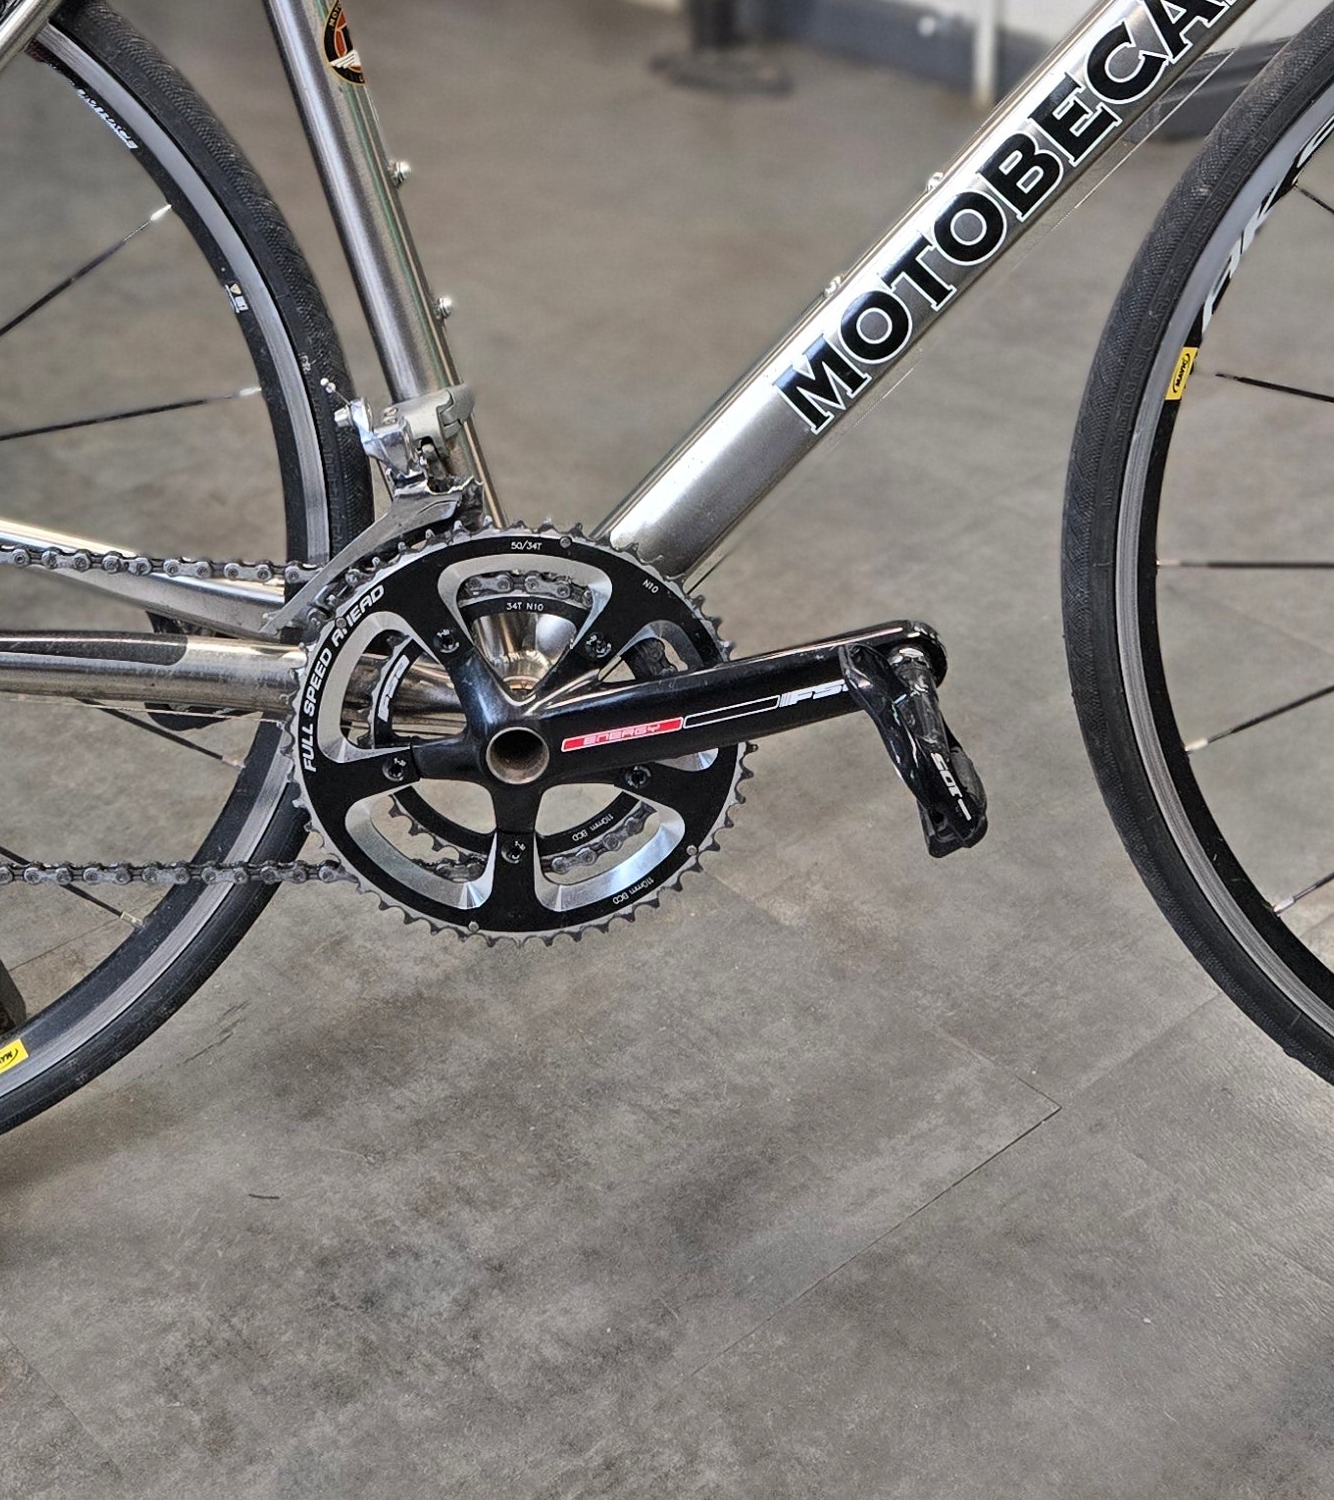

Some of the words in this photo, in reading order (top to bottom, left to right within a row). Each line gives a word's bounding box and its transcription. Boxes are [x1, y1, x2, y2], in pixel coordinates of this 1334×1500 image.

[1175, 360, 1189, 387] MAVIC
[511, 540, 542, 551] 50/34T
[642, 579, 660, 594] N10
[506, 602, 522, 611] 34T
[526, 603, 544, 612] N10
[303, 647, 333, 717] SPEED
[783, 679, 849, 706] FS
[582, 723, 662, 746] ENERGY
[301, 723, 317, 772] FULL
[930, 752, 963, 797] 105
[589, 813, 614, 832] 110mm
[630, 877, 654, 896] 110mm
